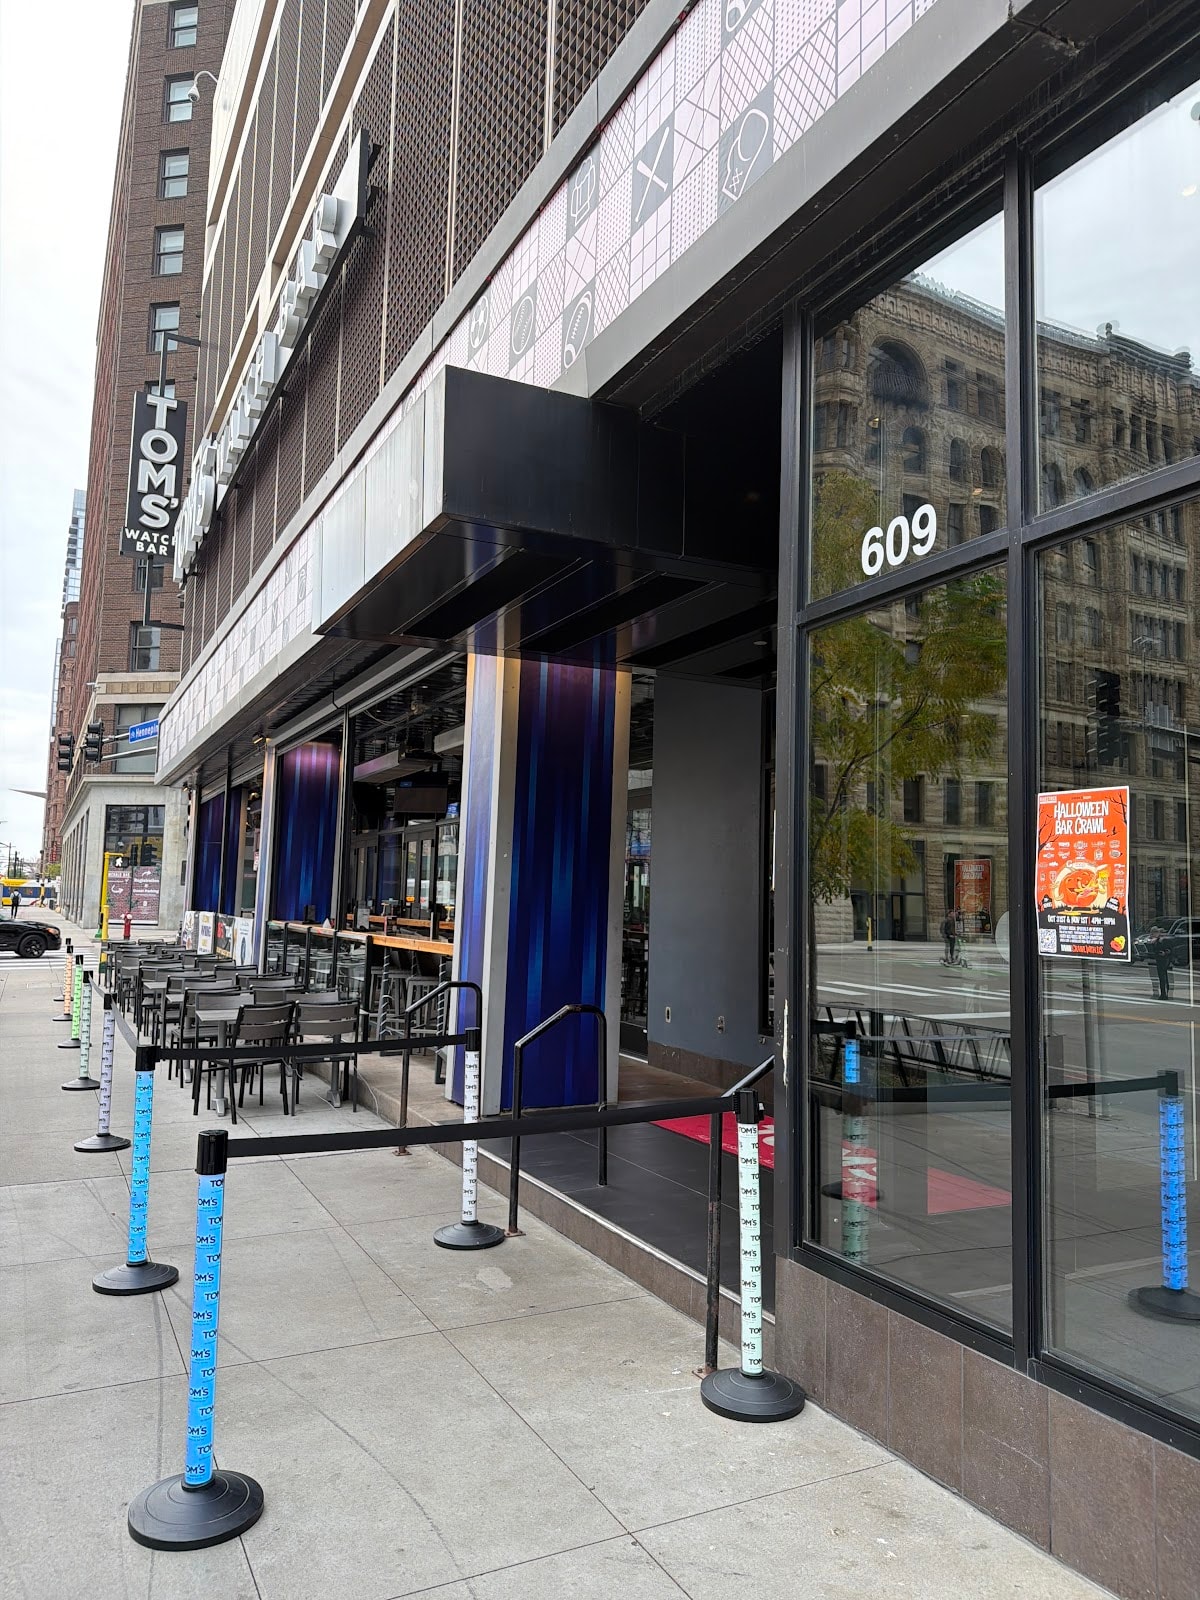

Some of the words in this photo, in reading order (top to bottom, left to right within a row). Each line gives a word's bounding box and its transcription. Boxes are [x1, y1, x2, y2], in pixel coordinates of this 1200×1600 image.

[137, 394, 179, 529] TOM'S
[136, 541, 168, 556] BAR
[861, 503, 937, 576] 609
[1054, 800, 1109, 821] HALLOWEEN
[1056, 820, 1073, 835] BAR
[1074, 817, 1107, 835] CRAWL
